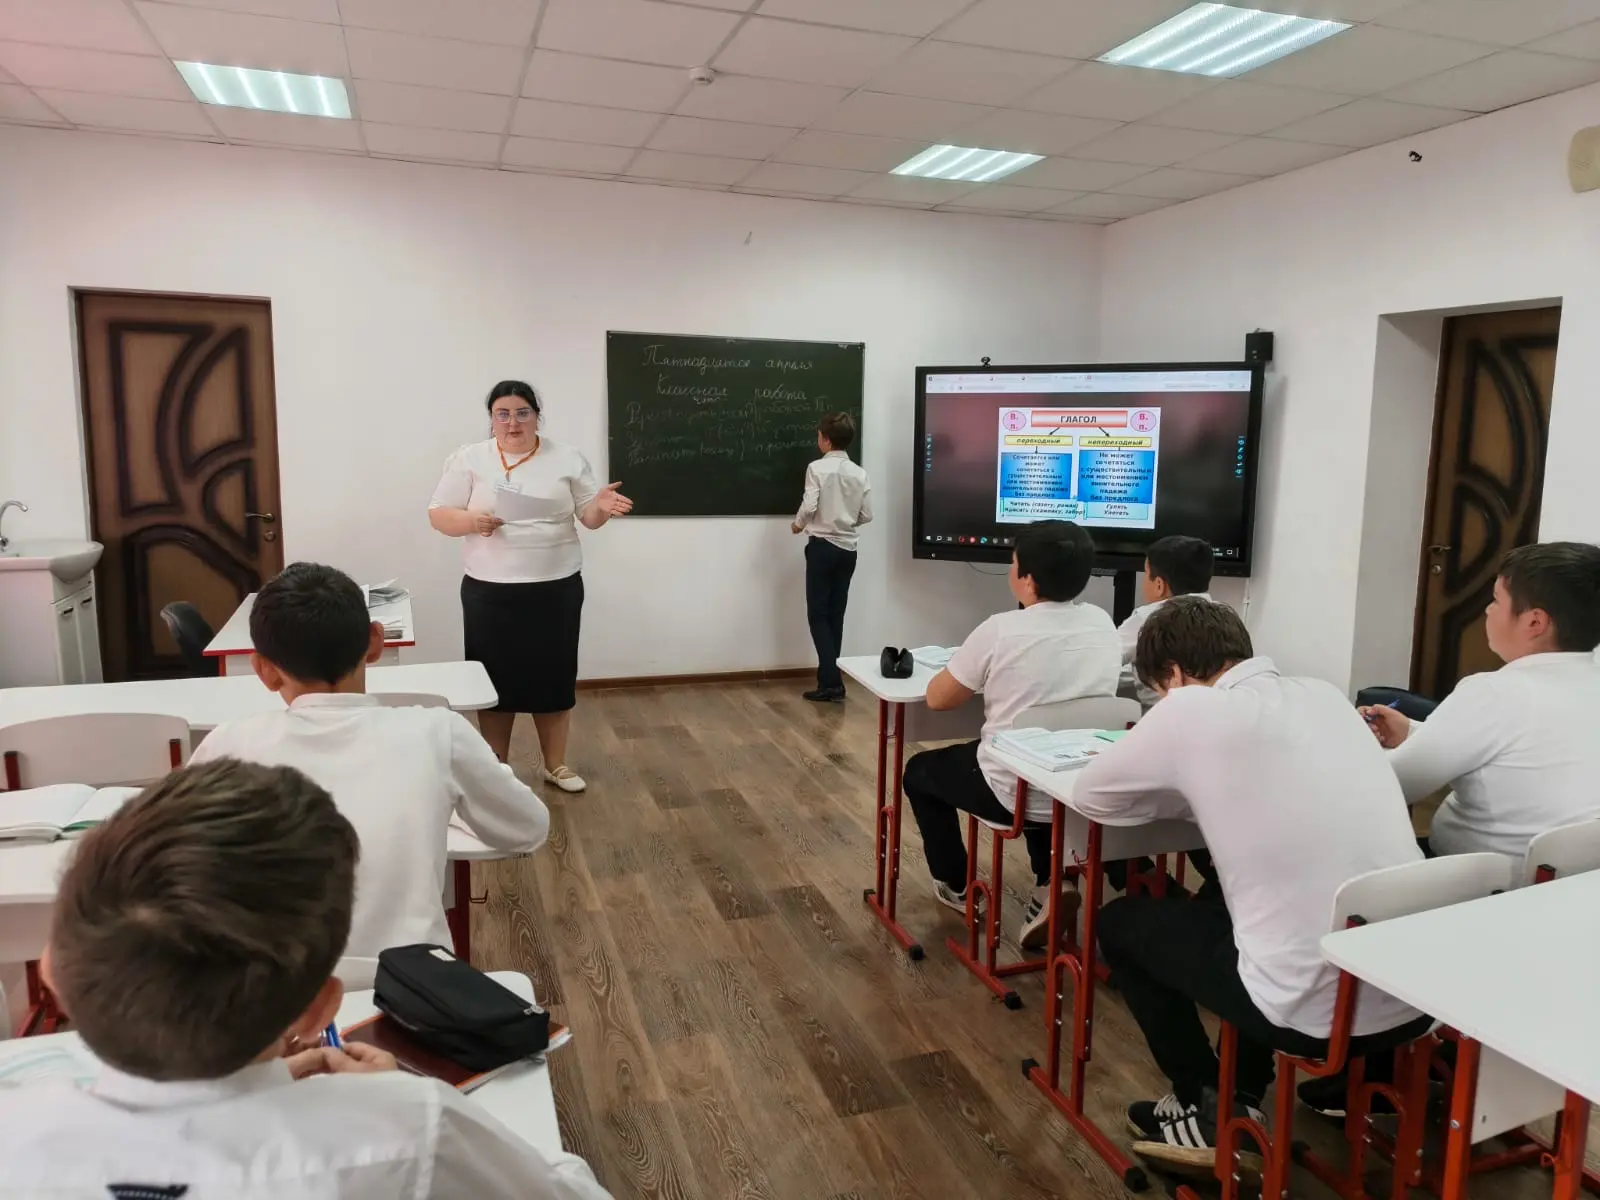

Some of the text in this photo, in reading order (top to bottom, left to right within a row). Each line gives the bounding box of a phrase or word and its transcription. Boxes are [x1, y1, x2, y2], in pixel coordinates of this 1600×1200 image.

[1060, 415, 1097, 423] ГЛАГОЛ
[1016, 437, 1061, 445] переходный
[1087, 438, 1143, 446] непереходный
